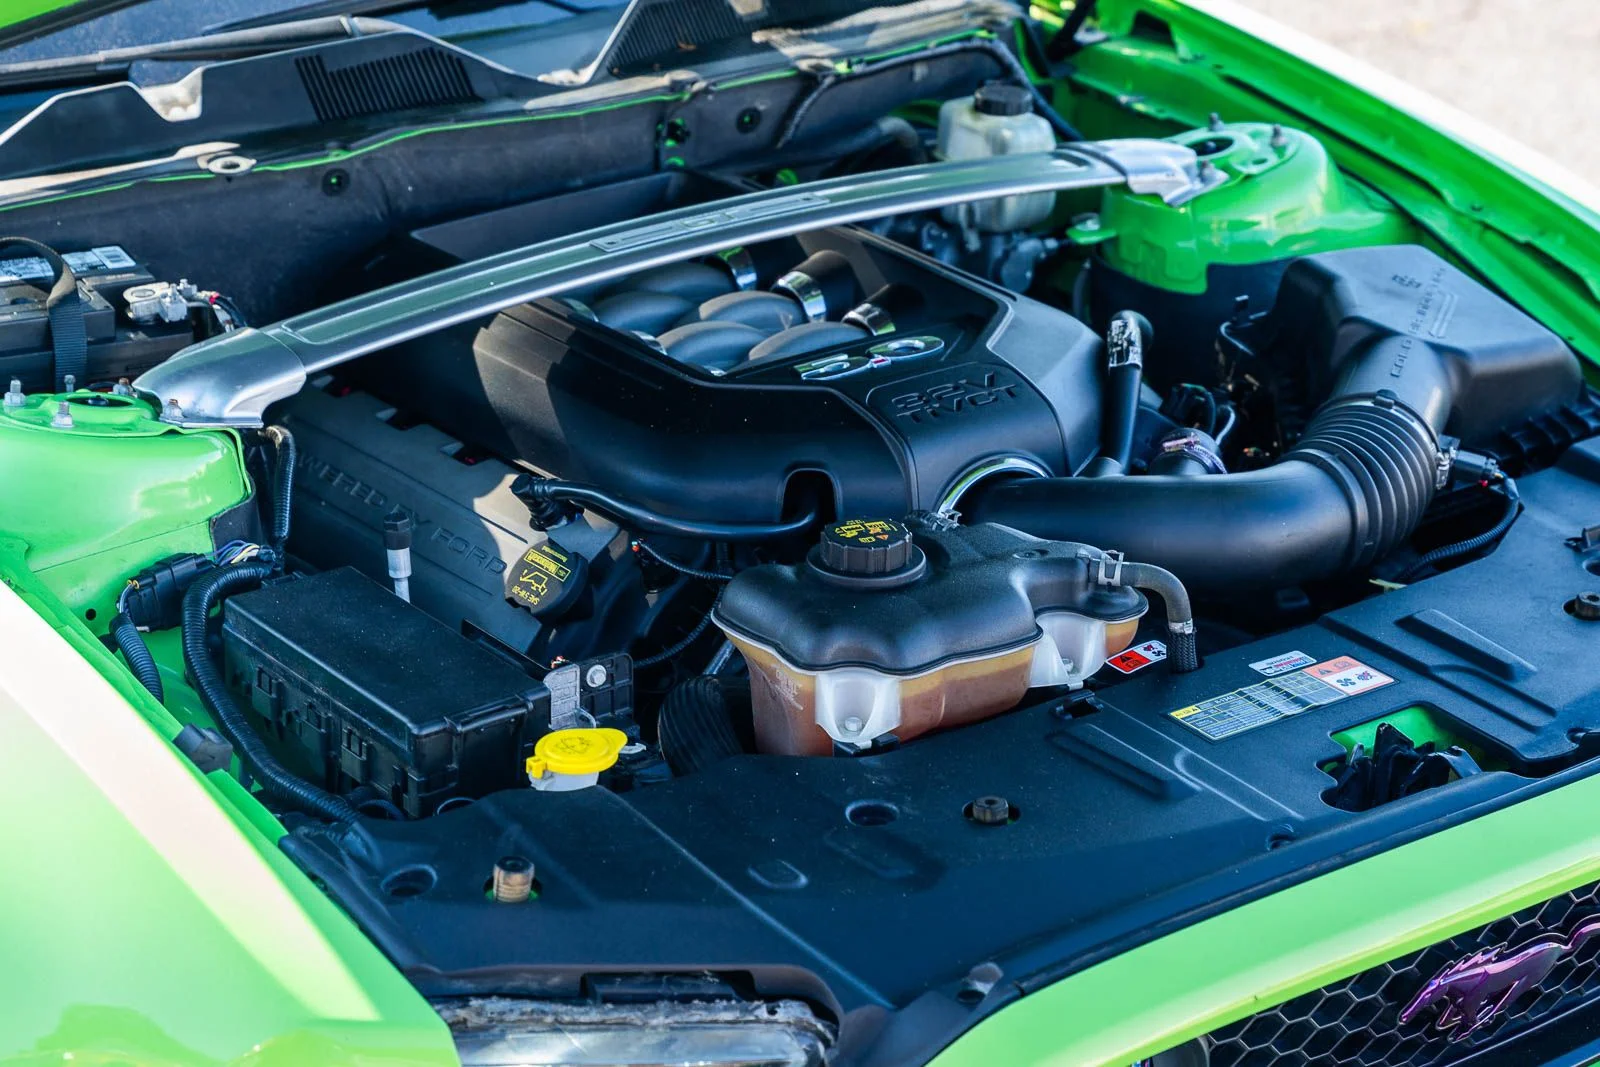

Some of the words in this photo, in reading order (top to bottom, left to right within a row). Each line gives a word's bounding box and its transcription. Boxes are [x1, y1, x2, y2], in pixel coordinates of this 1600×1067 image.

[297, 453, 389, 506] WERED
[430, 526, 508, 576] FORD
[527, 593, 540, 606] SAE
